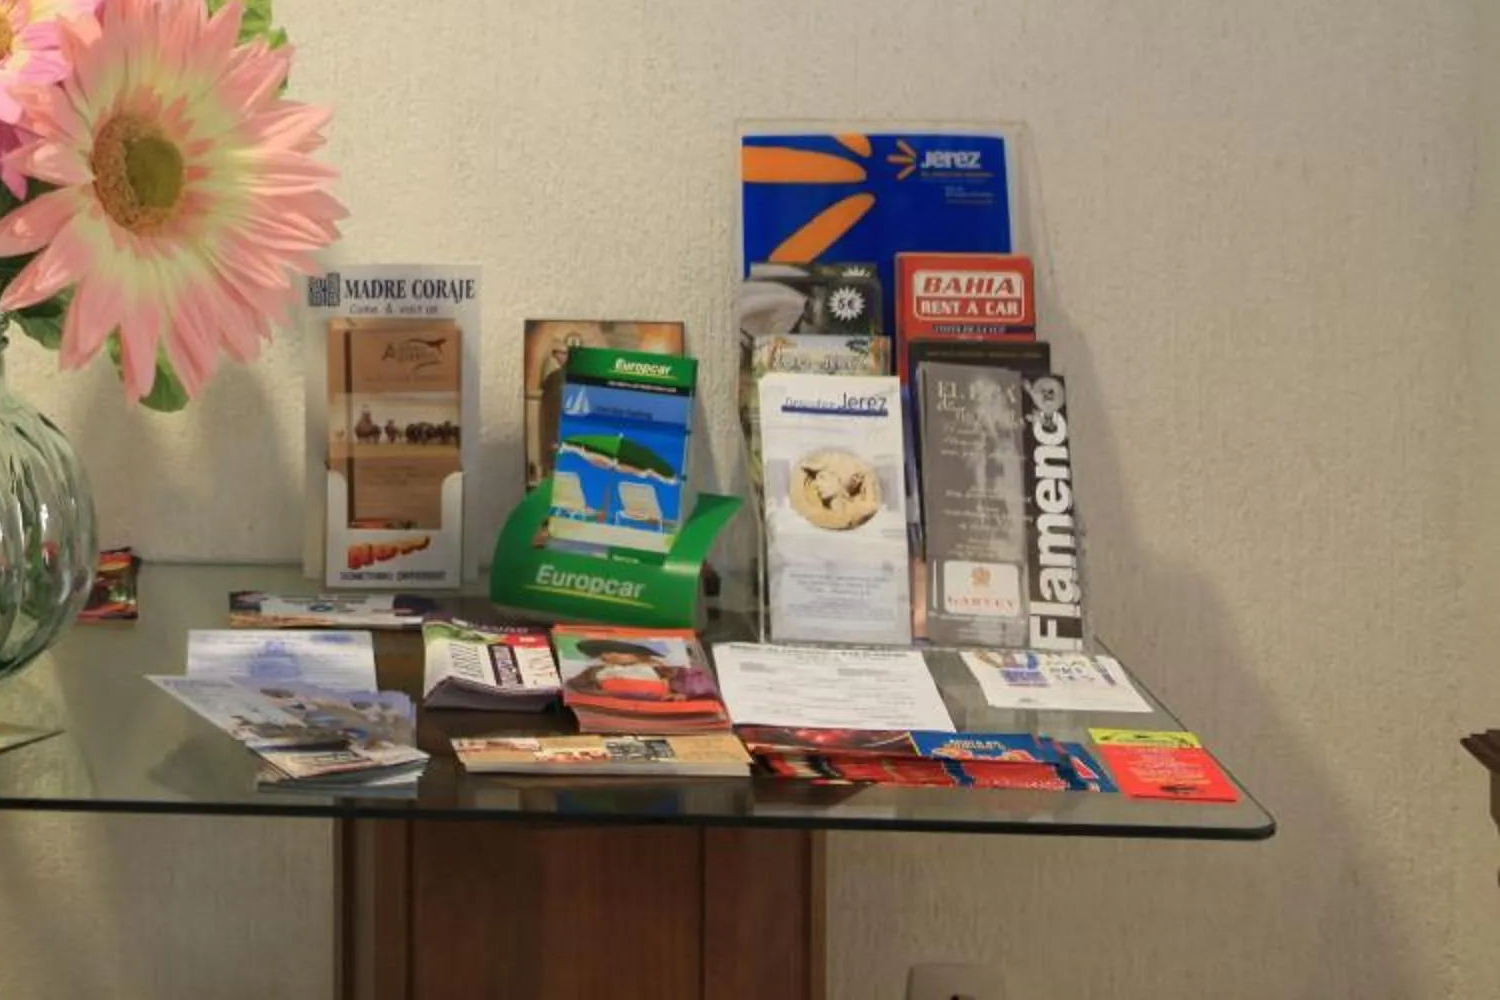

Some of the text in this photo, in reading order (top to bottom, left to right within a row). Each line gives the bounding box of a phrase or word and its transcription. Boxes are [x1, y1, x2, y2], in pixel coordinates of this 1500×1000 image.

[921, 150, 981, 170] Jerez
[344, 279, 476, 304] MADRE CORAJE
[922, 277, 1015, 294] BAHIA
[921, 300, 1018, 316] RENT A CAR
[615, 357, 672, 377] Europcar
[839, 391, 887, 411] Jerez
[536, 564, 646, 599] Europcar
